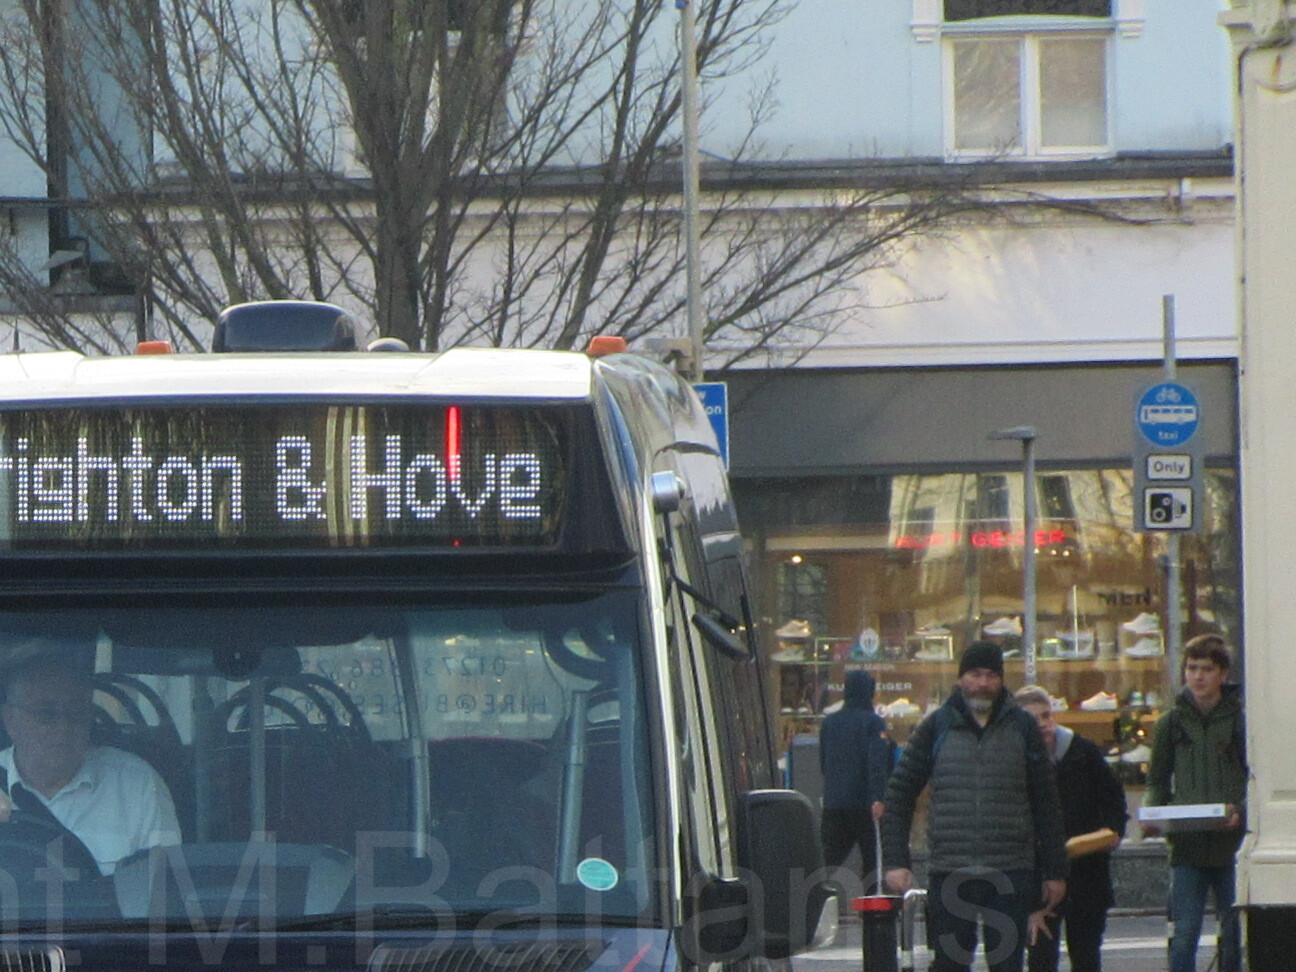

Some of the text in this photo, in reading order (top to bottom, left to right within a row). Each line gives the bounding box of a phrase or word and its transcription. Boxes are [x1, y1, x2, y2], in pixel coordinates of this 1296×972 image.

[1158, 430, 1179, 441] taxi
[1154, 460, 1186, 475] Only
[275, 434, 327, 520] &
[350, 434, 542, 520] Hove
[875, 681, 912, 691] EIGER
